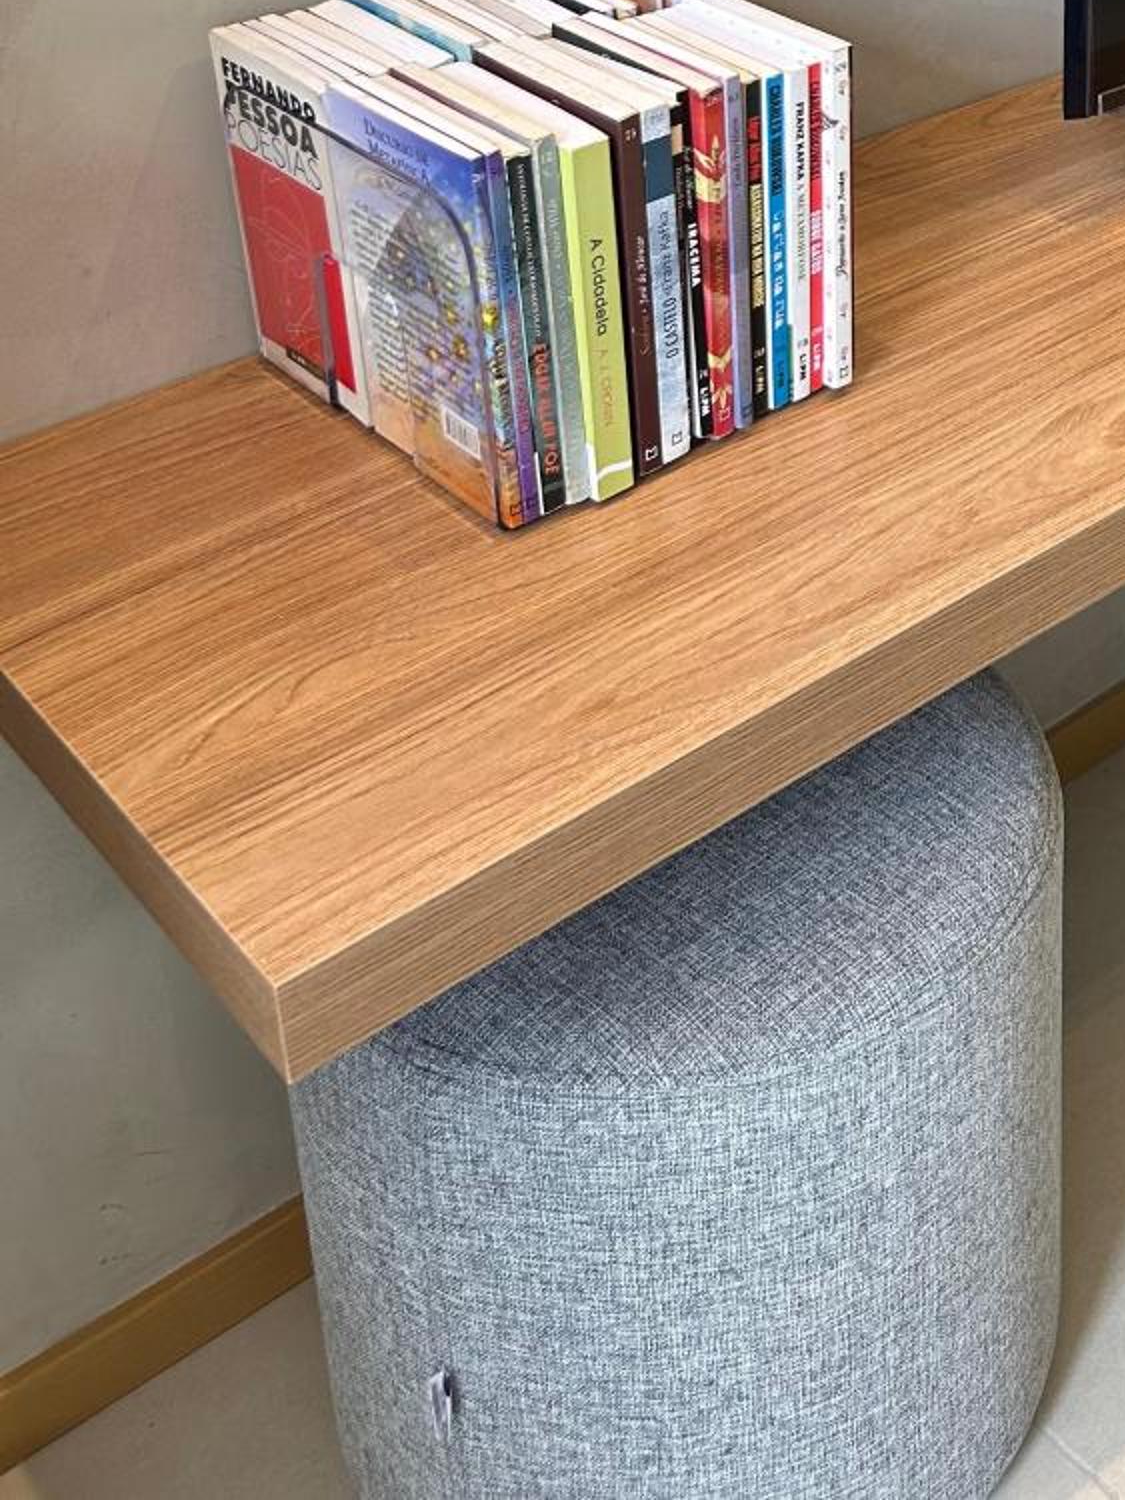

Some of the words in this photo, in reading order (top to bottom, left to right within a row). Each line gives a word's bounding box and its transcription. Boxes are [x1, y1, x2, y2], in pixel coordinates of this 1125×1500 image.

[221, 57, 317, 124] FERNANDO
[225, 80, 320, 160] PESSOA
[796, 101, 805, 140] FRANZ
[226, 110, 322, 191] POESIAS
[796, 141, 804, 180] KAFKA
[591, 239, 603, 251] A
[658, 211, 670, 250] Kafka
[687, 222, 701, 288] IRACEMA
[592, 255, 608, 337] Cidadela
[663, 296, 678, 347] CASTELO
[667, 347, 679, 359] O
